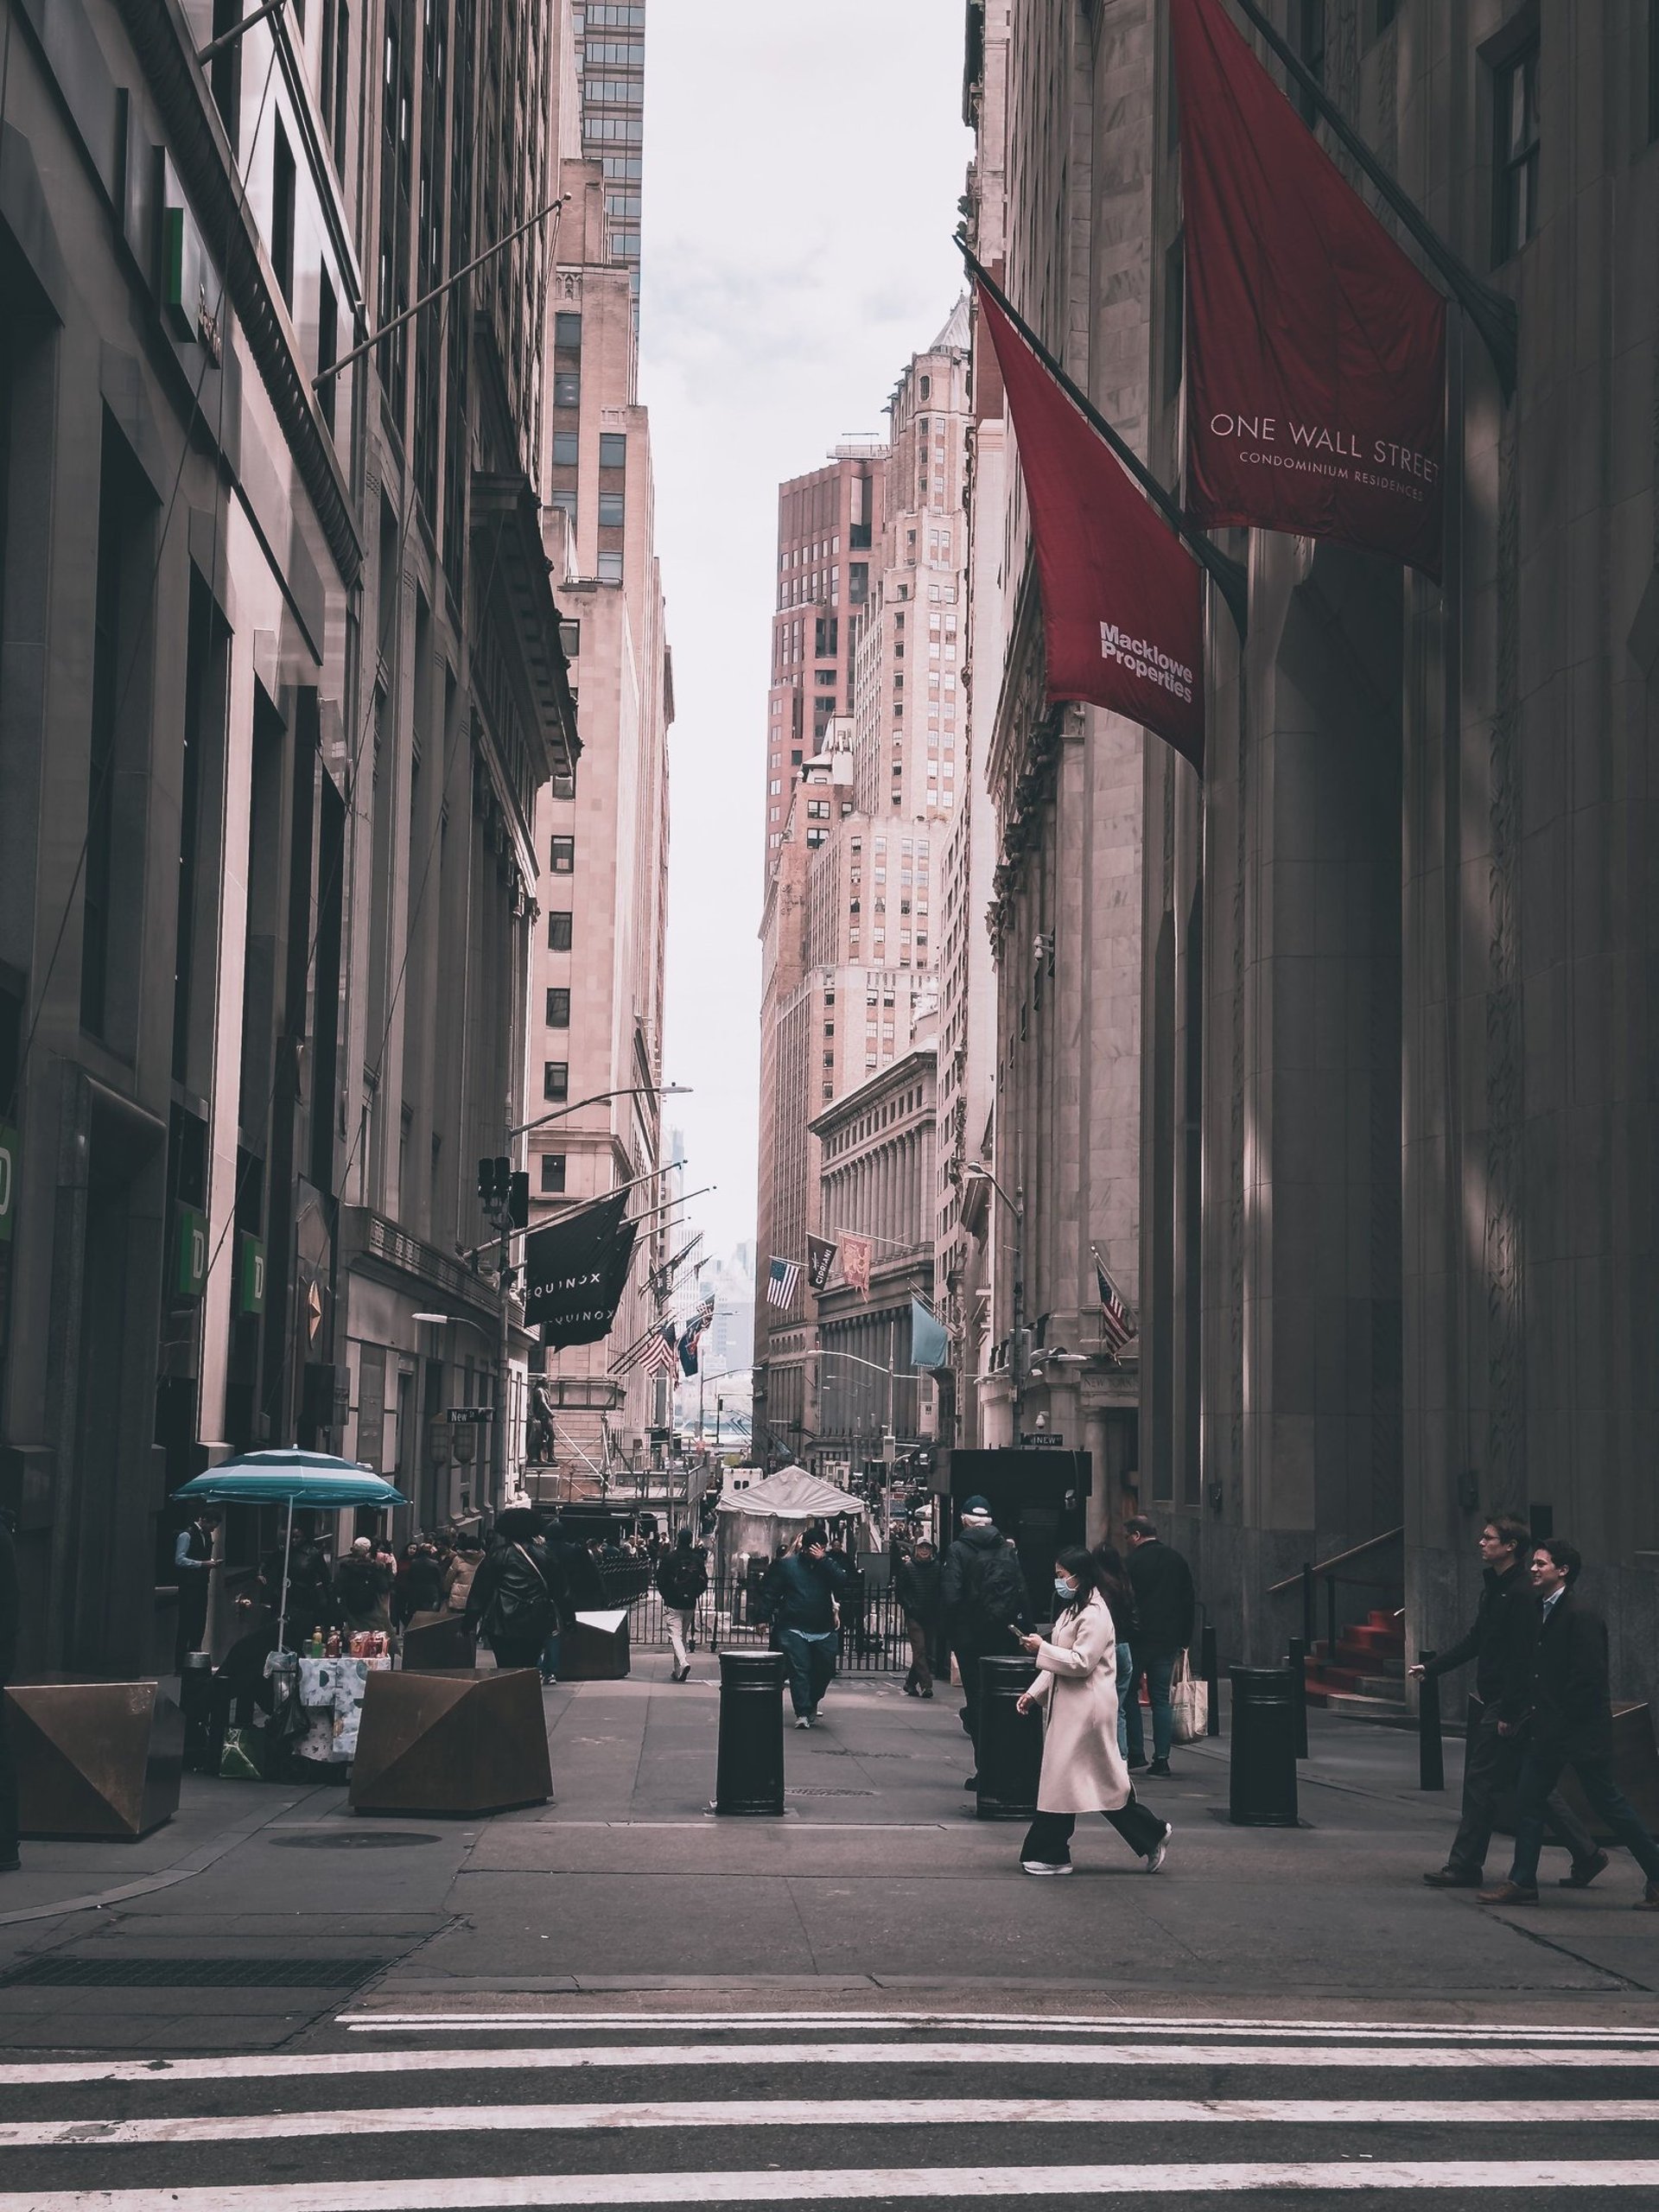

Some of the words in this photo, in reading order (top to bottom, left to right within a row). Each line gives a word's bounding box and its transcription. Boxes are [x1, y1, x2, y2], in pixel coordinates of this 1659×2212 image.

[1210, 413, 1276, 442] ONE
[1288, 422, 1363, 458] WALL
[1373, 440, 1440, 486] STREET
[1239, 451, 1349, 480] CONDOMINIUM
[1354, 471, 1425, 501] RESIDENCES
[1099, 620, 1193, 684] Macklowe
[1101, 639, 1192, 704] Properties
[815, 1249, 832, 1285] CIPRIANI
[451, 1410, 467, 1422] New
[1037, 1436, 1056, 1445] NEW
